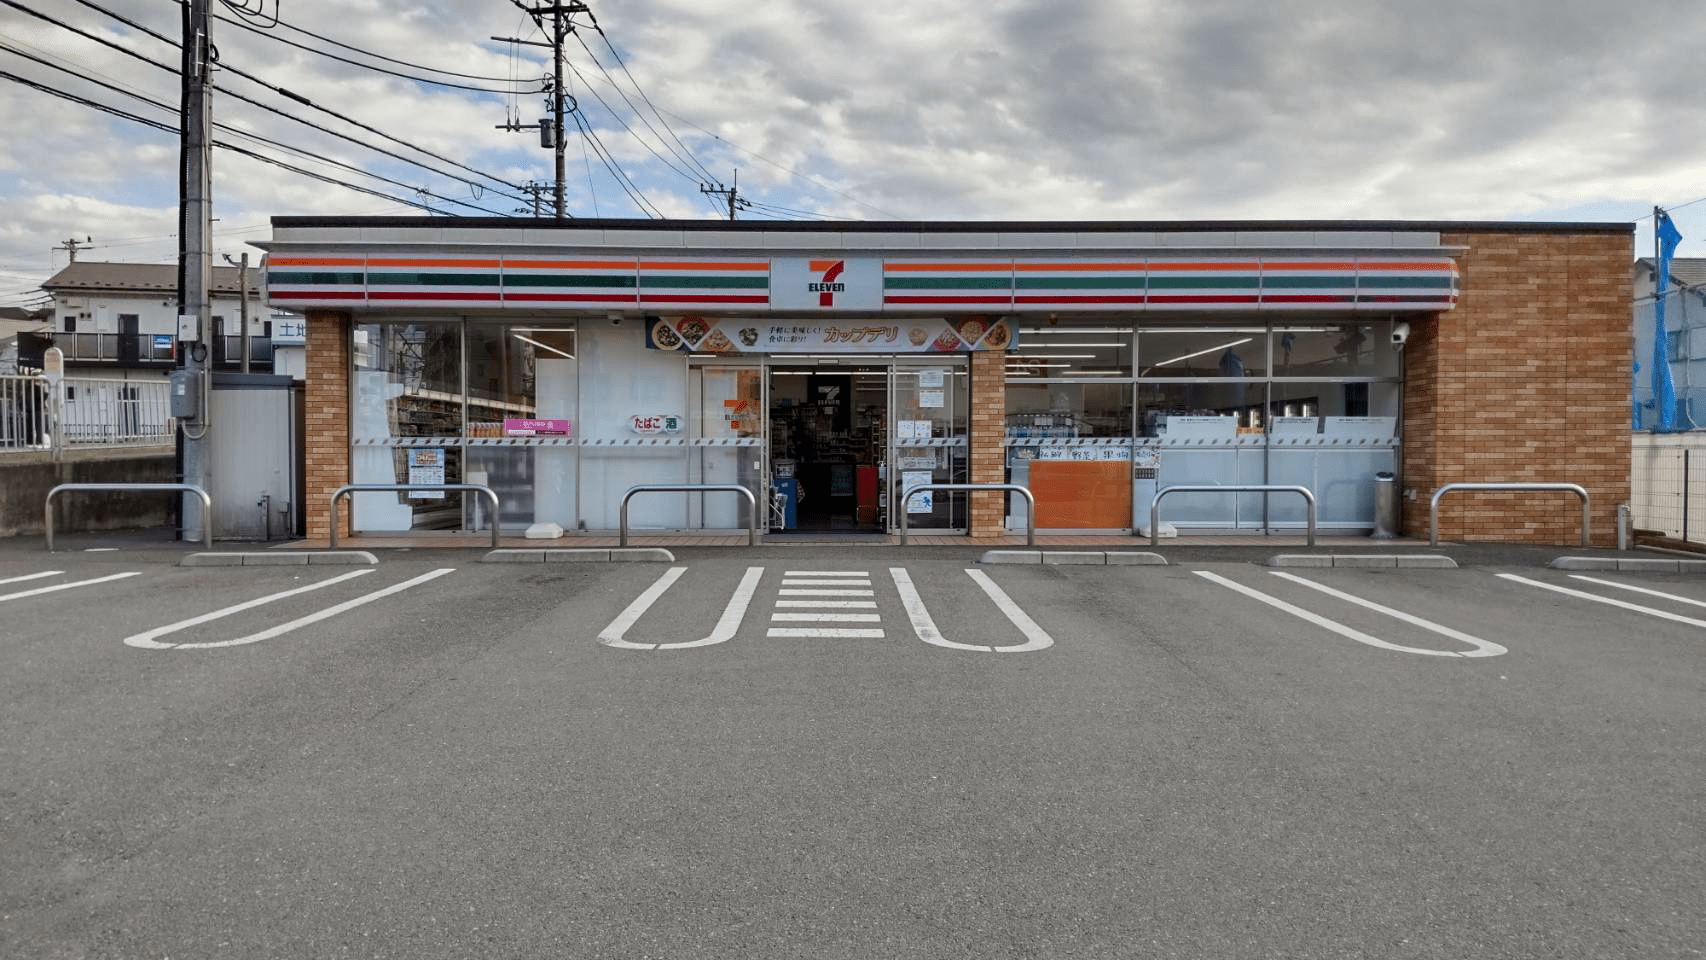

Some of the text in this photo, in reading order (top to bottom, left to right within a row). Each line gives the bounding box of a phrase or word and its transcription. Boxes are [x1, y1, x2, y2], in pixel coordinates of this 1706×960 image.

[809, 259, 845, 306] 7
[824, 326, 899, 343] カップデリ
[634, 417, 677, 429] たばこ 酒
